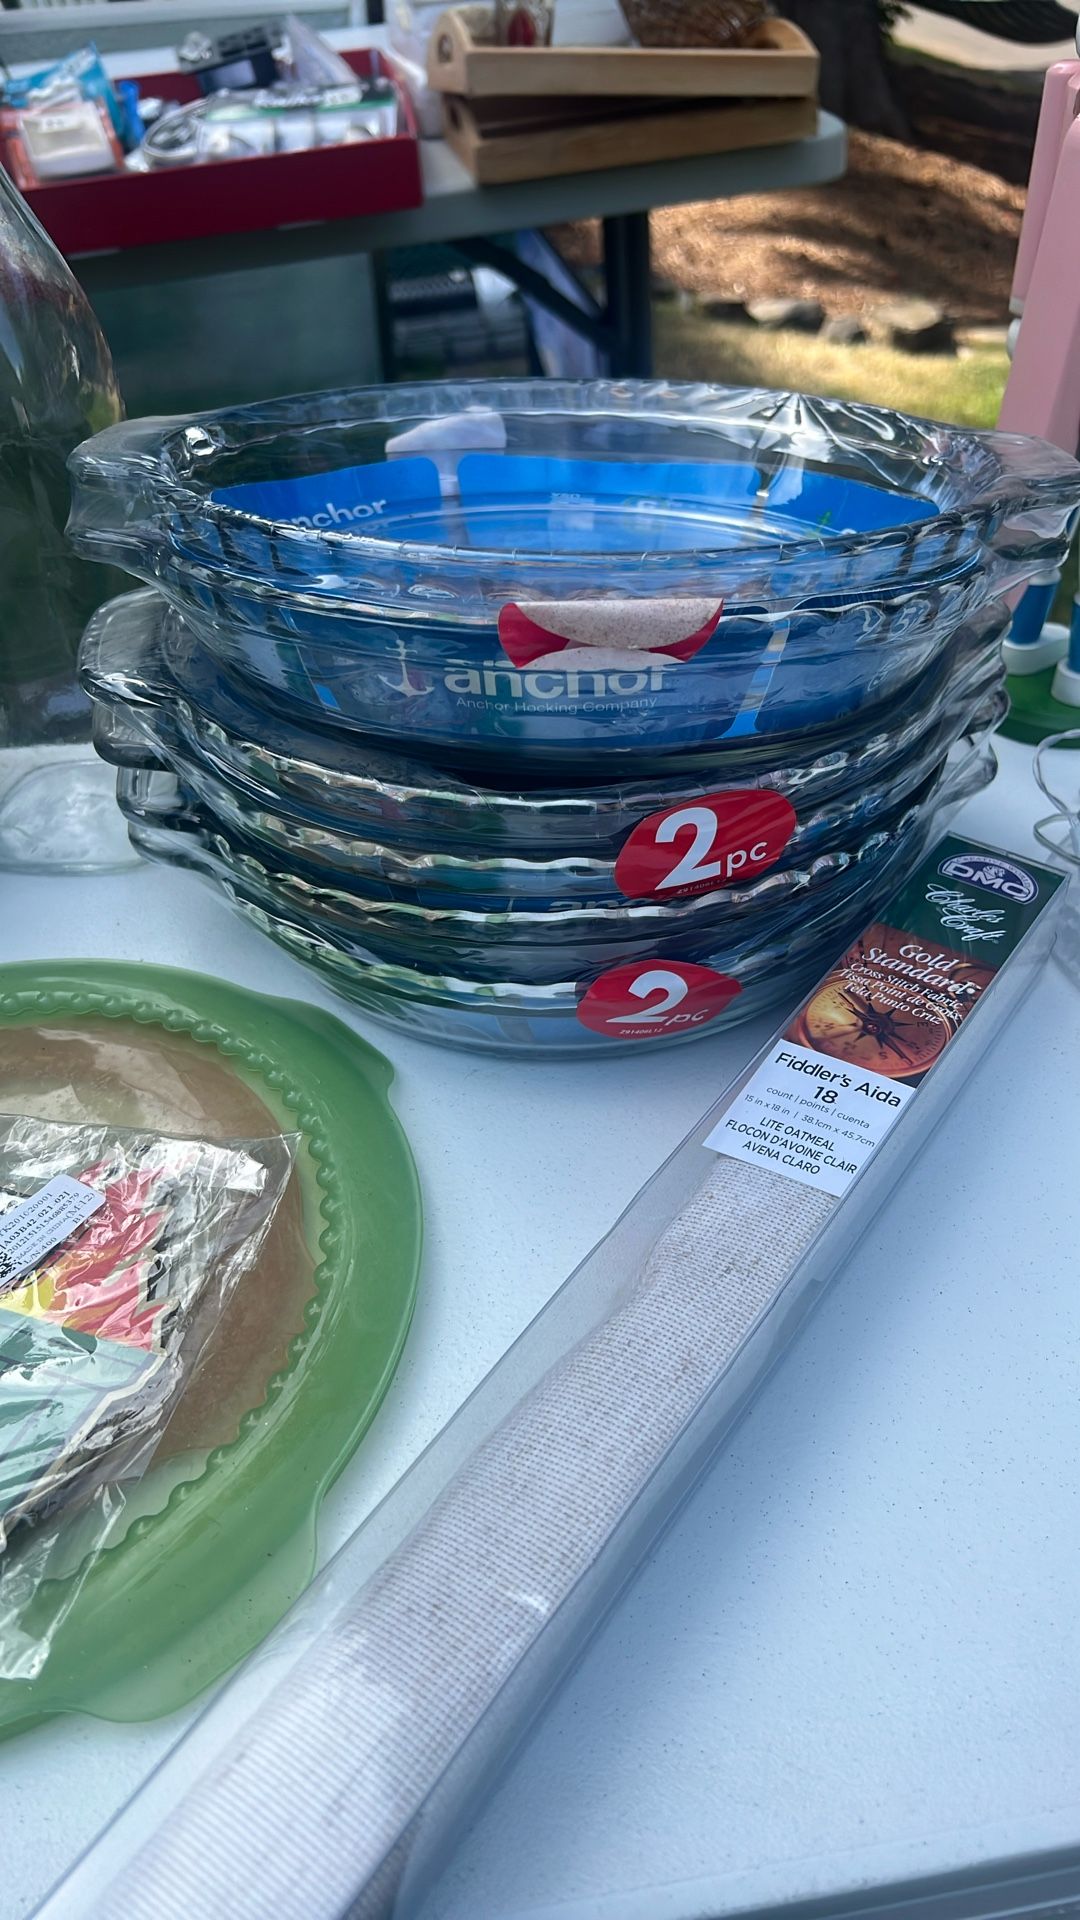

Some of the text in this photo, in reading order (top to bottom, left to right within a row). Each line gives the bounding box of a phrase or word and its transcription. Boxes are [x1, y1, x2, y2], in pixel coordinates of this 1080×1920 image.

[456, 696, 657, 714] Anchor Hocking Company
[655, 806, 768, 890] 2 pc
[944, 861, 1030, 898] DMC
[925, 883, 1005, 923] Charles
[940, 907, 1007, 941] Craft
[899, 944, 959, 971] Gold
[605, 970, 709, 1026] 2 pc
[844, 982, 944, 1025] Tela Punto Cruz
[850, 963, 963, 1009] Cross Stitch Fabric
[870, 980, 906, 999] Point
[906, 994, 925, 1007] de
[925, 1002, 963, 1021] Croix
[766, 1087, 793, 1102] count
[799, 1098, 830, 1115] points
[837, 1112, 871, 1129] cuenta
[813, 1086, 839, 1104] 18
[854, 1082, 902, 1108] Aida
[744, 1094, 754, 1103] 15
[755, 1097, 764, 1107] in
[781, 1106, 790, 1116] in
[801, 1114, 832, 1131] 38.1cm
[841, 1130, 876, 1148] 45.7cm
[760, 1117, 835, 1152] LITE OATMEAL
[725, 1119, 858, 1174] FLOCON D'AVOINE CLAIR
[742, 1140, 821, 1175] AVENA CLARO
